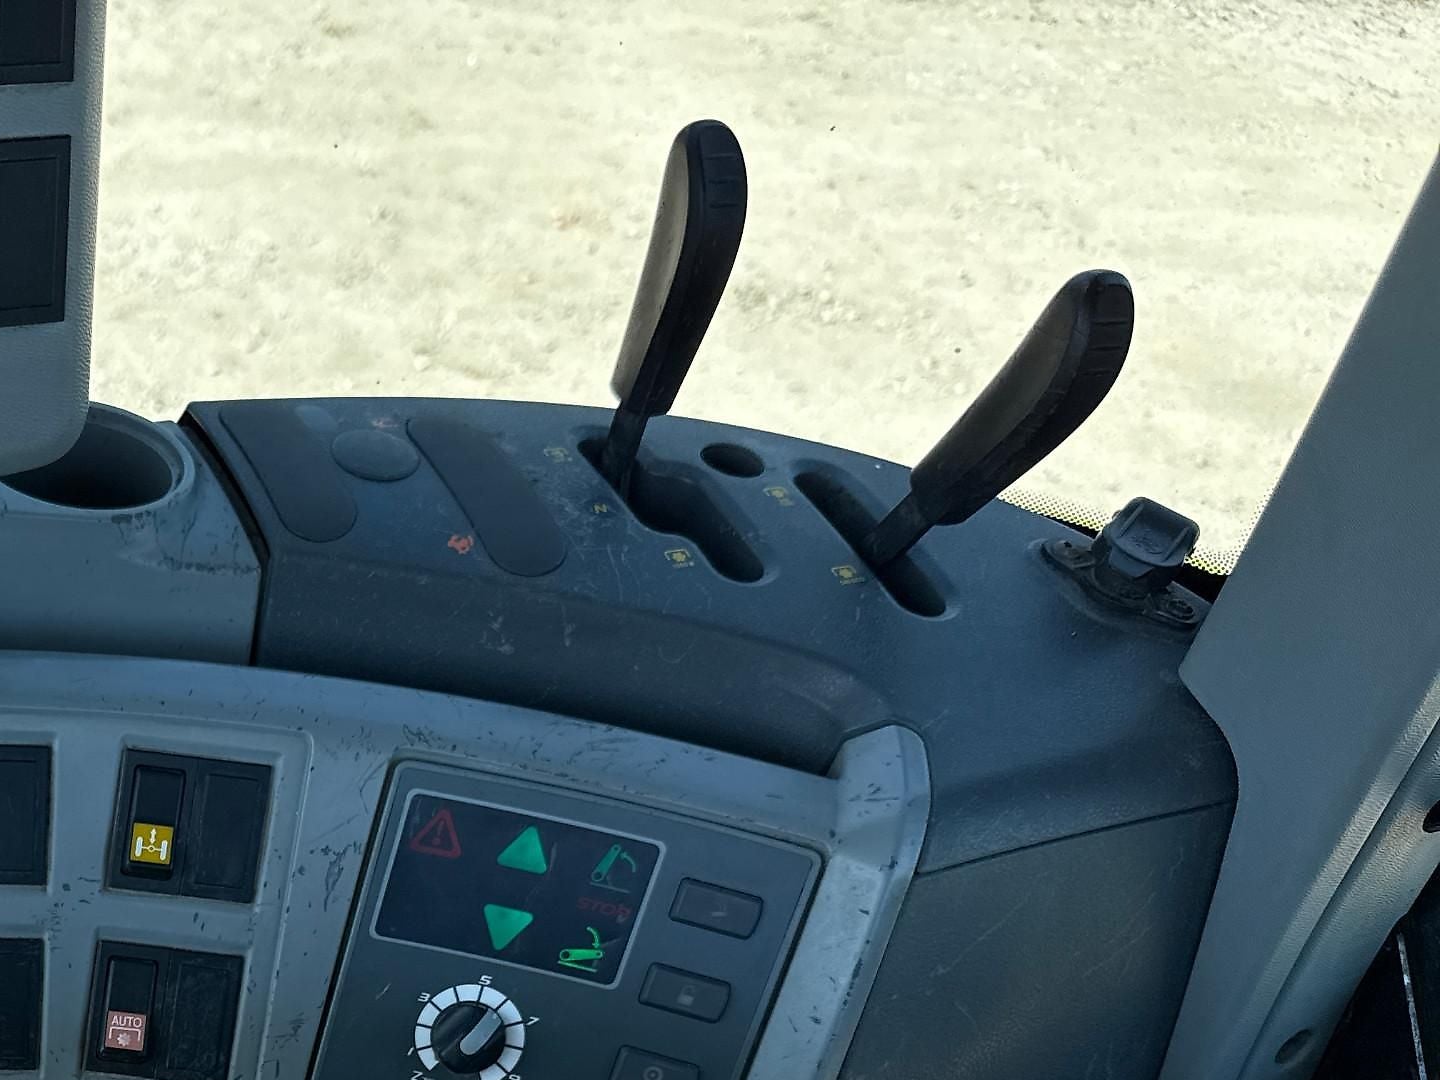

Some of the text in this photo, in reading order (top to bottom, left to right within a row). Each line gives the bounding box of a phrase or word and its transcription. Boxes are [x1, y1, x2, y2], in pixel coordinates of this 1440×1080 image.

[477, 974, 493, 986] 5
[417, 992, 431, 1002] 3
[112, 1015, 142, 1028] AUTO
[525, 1015, 540, 1026] 7
